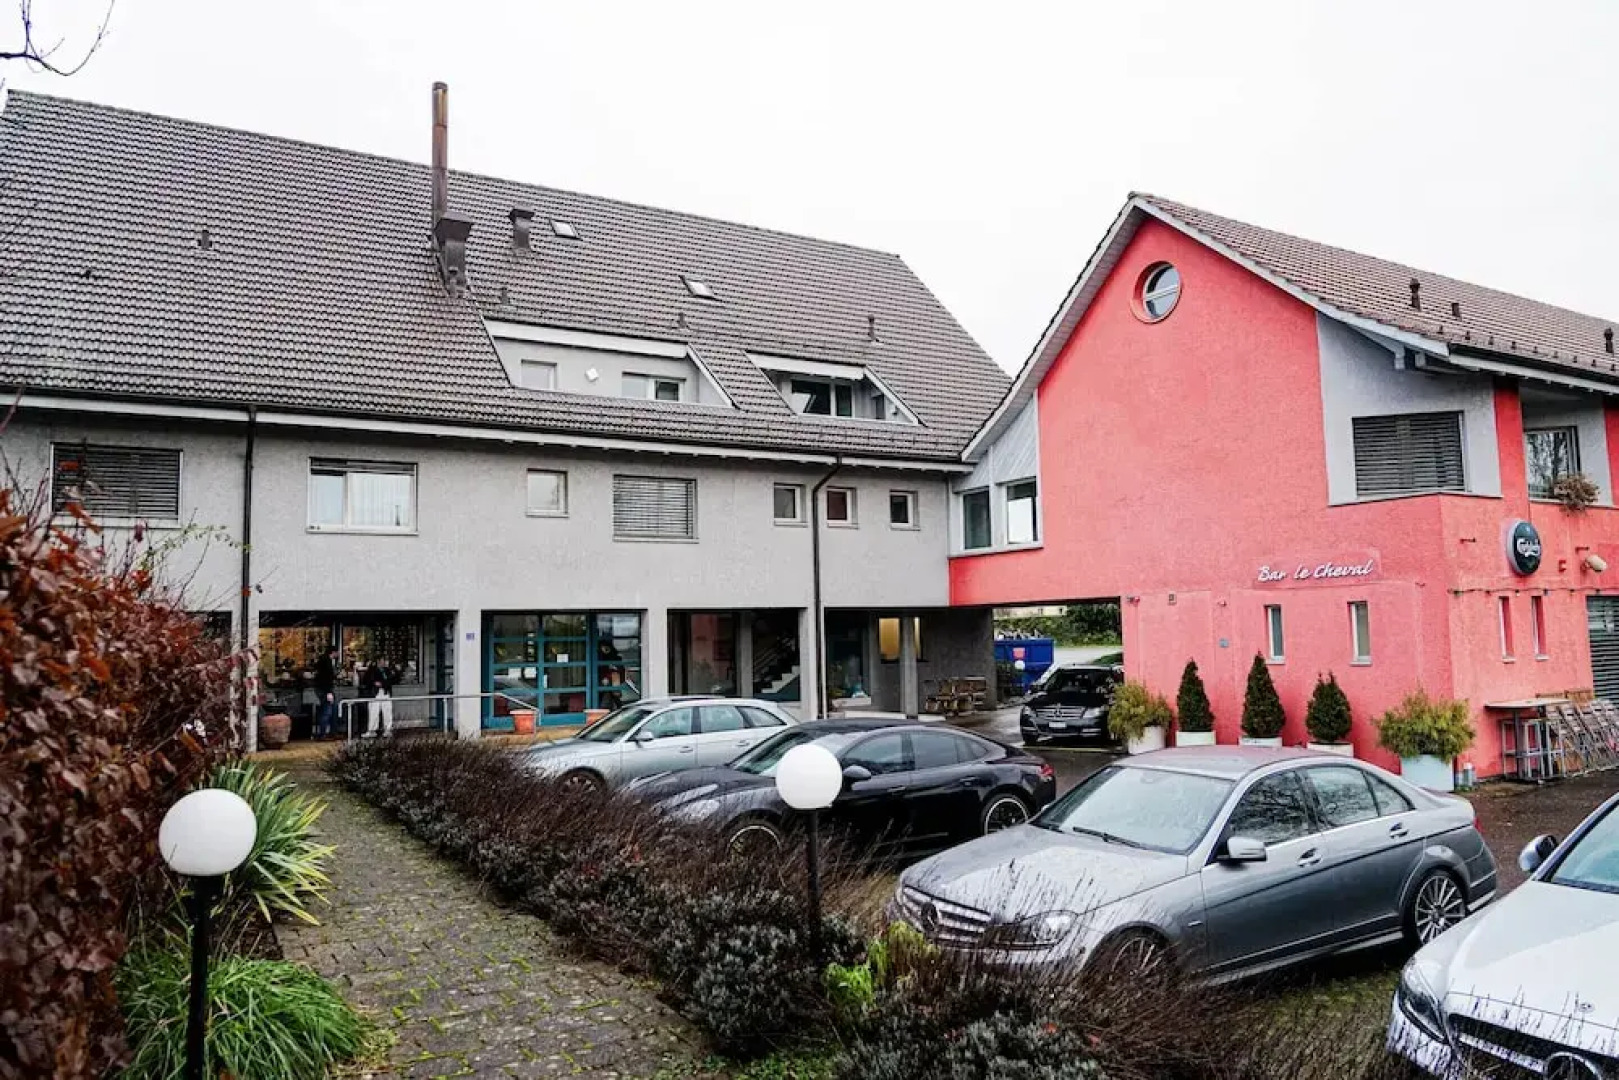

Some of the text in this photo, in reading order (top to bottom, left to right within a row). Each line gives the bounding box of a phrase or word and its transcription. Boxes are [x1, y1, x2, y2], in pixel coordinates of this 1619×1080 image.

[1258, 559, 1374, 582] Bar le Cheval
